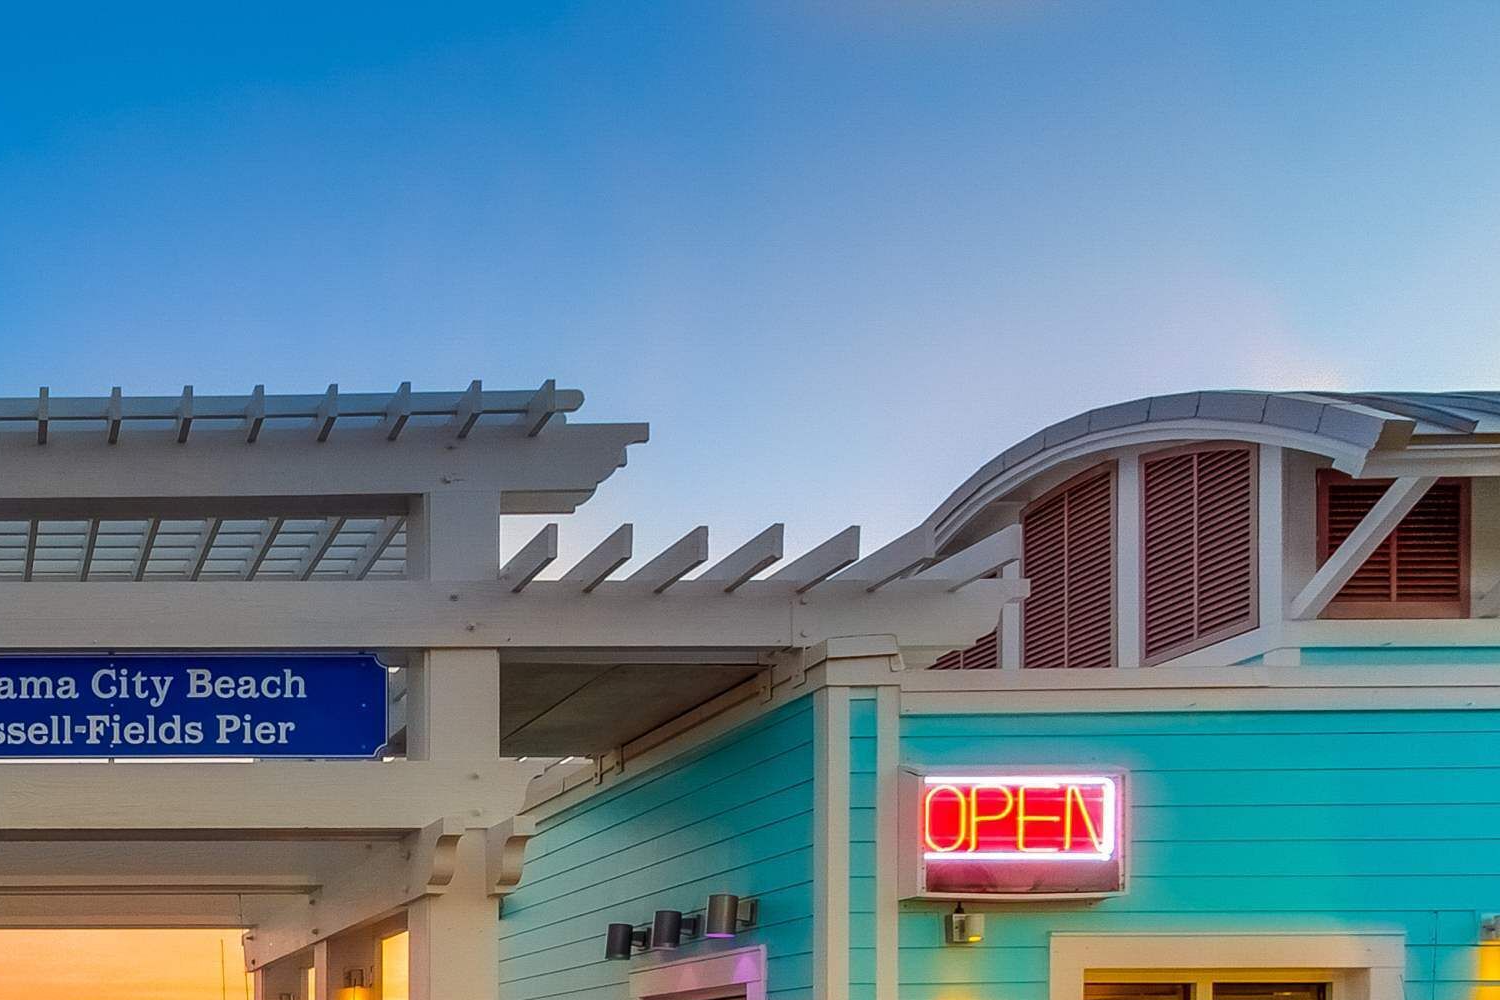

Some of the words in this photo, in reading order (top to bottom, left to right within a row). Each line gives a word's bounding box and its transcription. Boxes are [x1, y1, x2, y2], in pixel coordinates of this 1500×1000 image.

[91, 668, 174, 707] City
[186, 669, 307, 699] Beach
[216, 715, 296, 744] Pier
[925, 784, 1113, 853] OPEN
